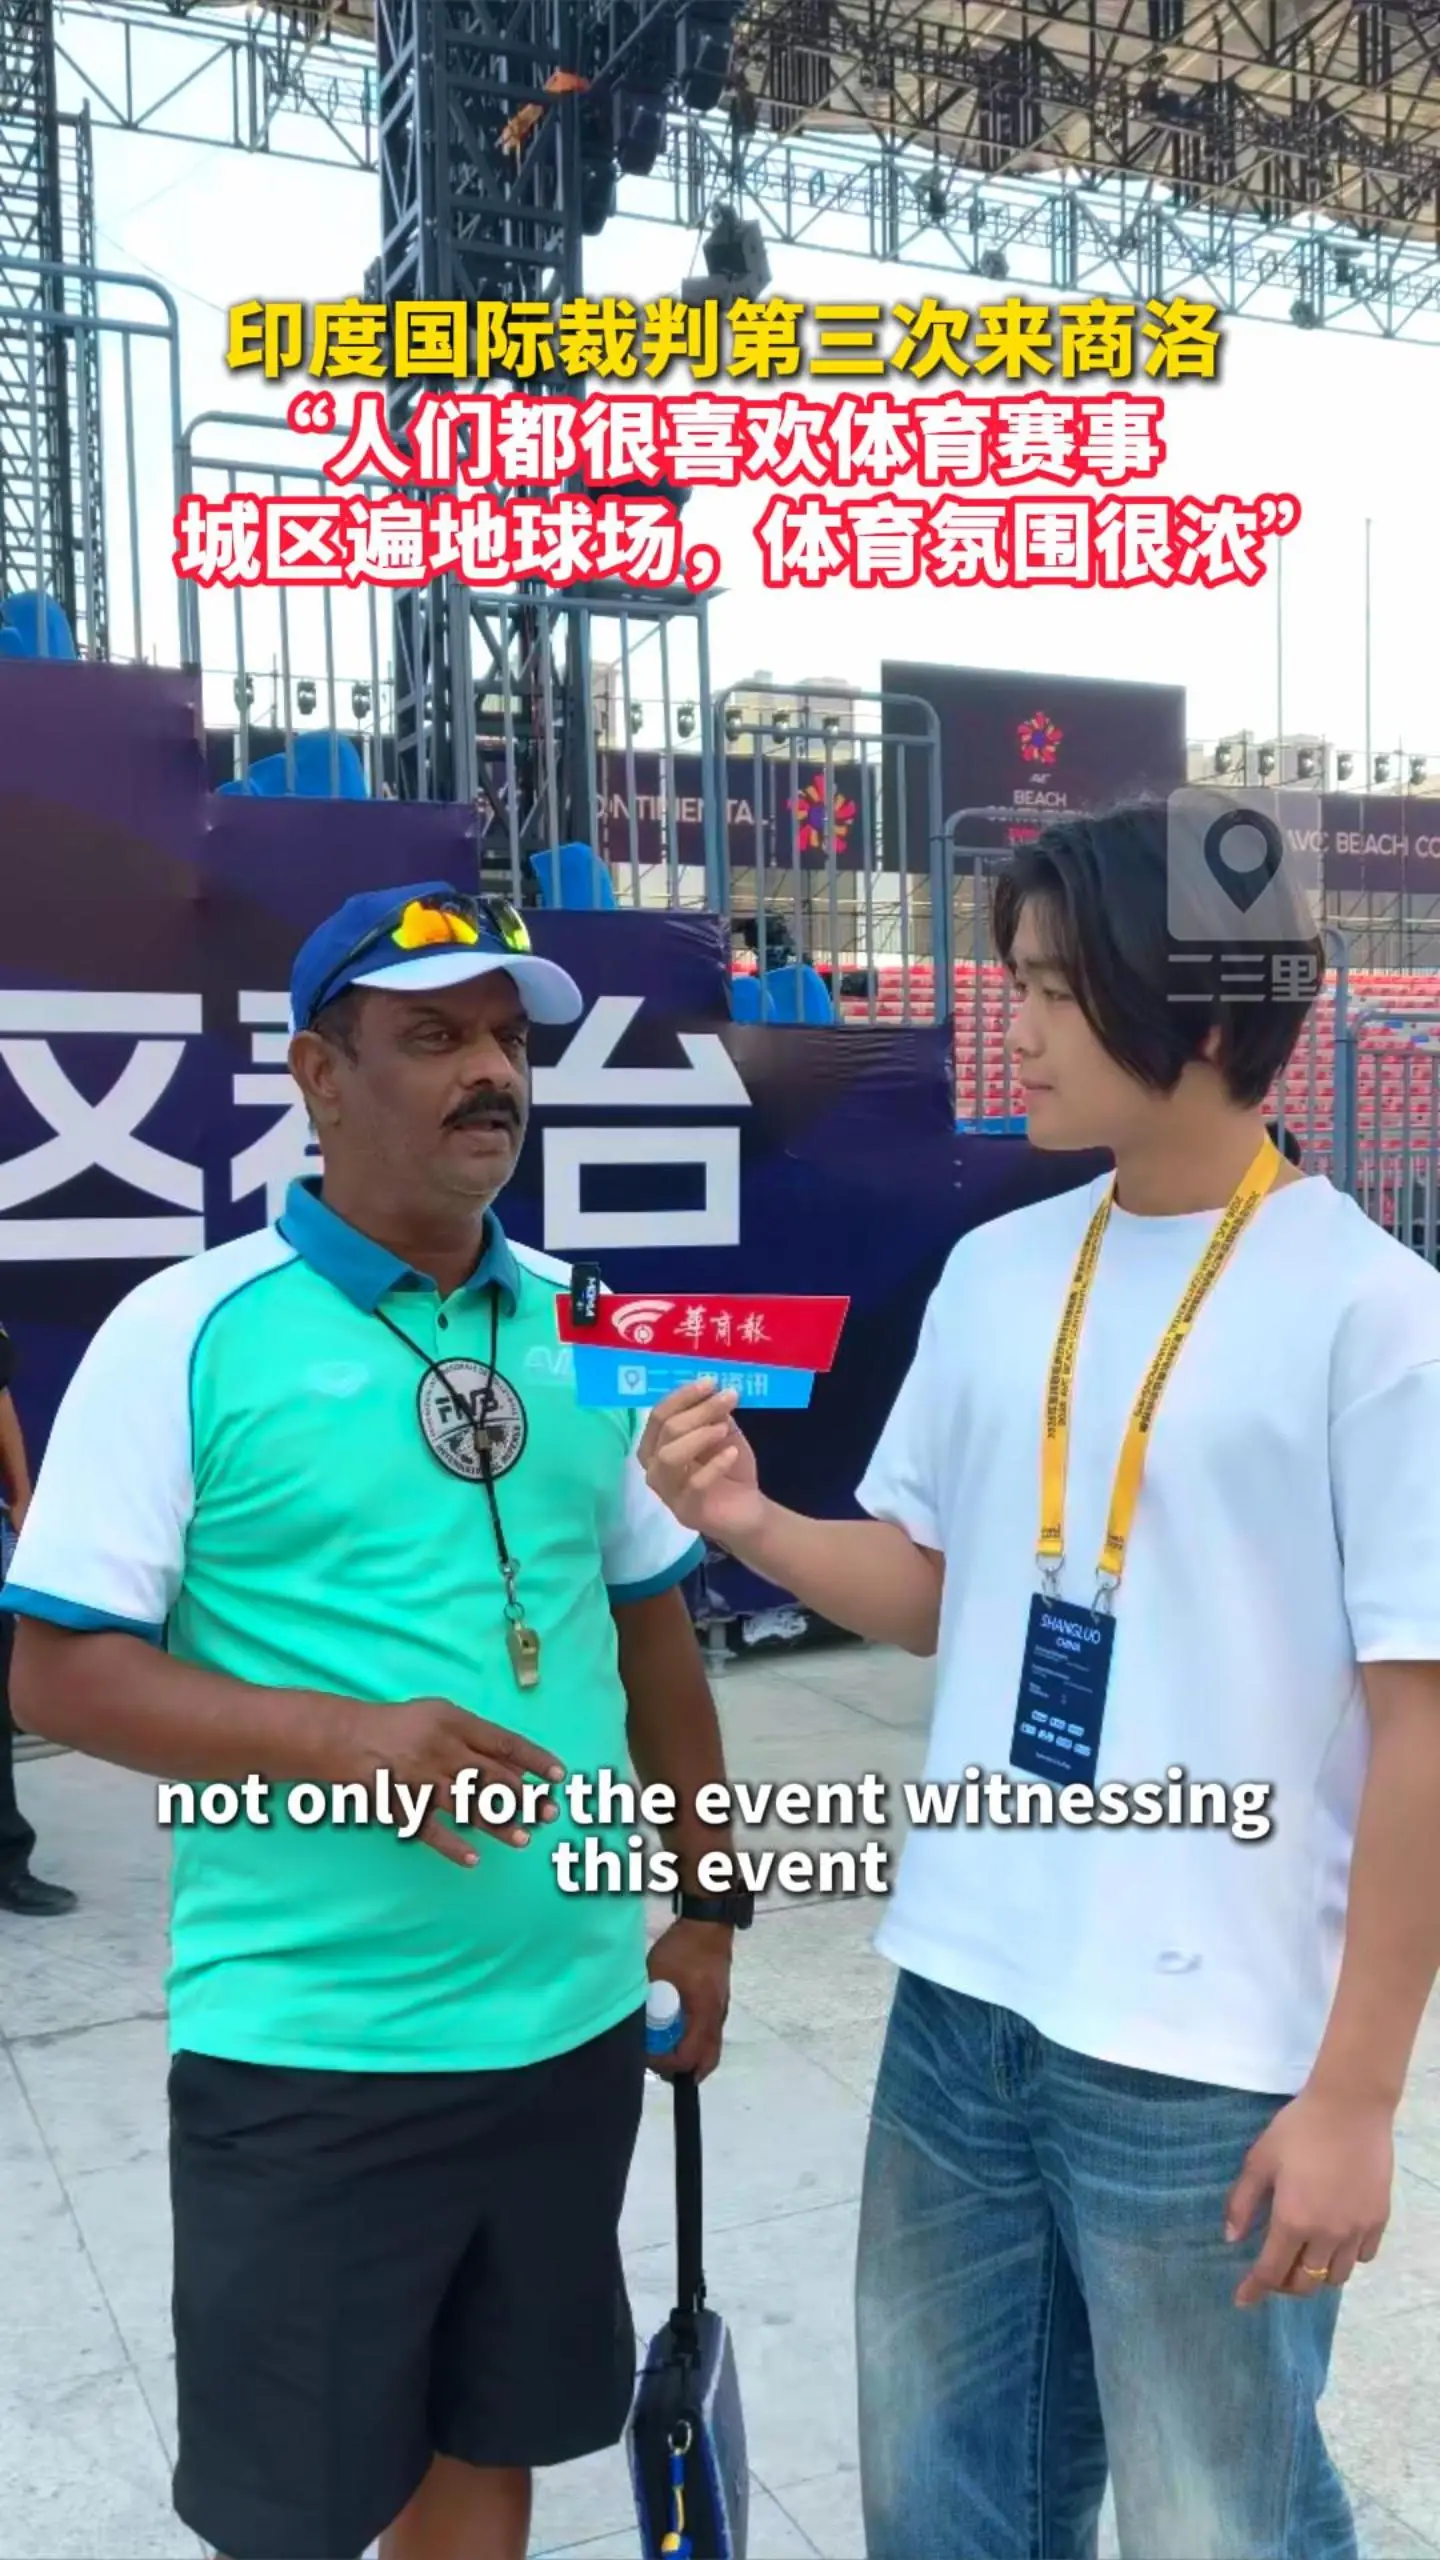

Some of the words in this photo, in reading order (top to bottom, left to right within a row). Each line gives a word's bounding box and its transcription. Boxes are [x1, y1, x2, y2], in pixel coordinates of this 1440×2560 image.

[1013, 789, 1067, 807] BEACH
[1336, 832, 1409, 856] BEACH
[1040, 1613, 1101, 1645] SHANGLUO
